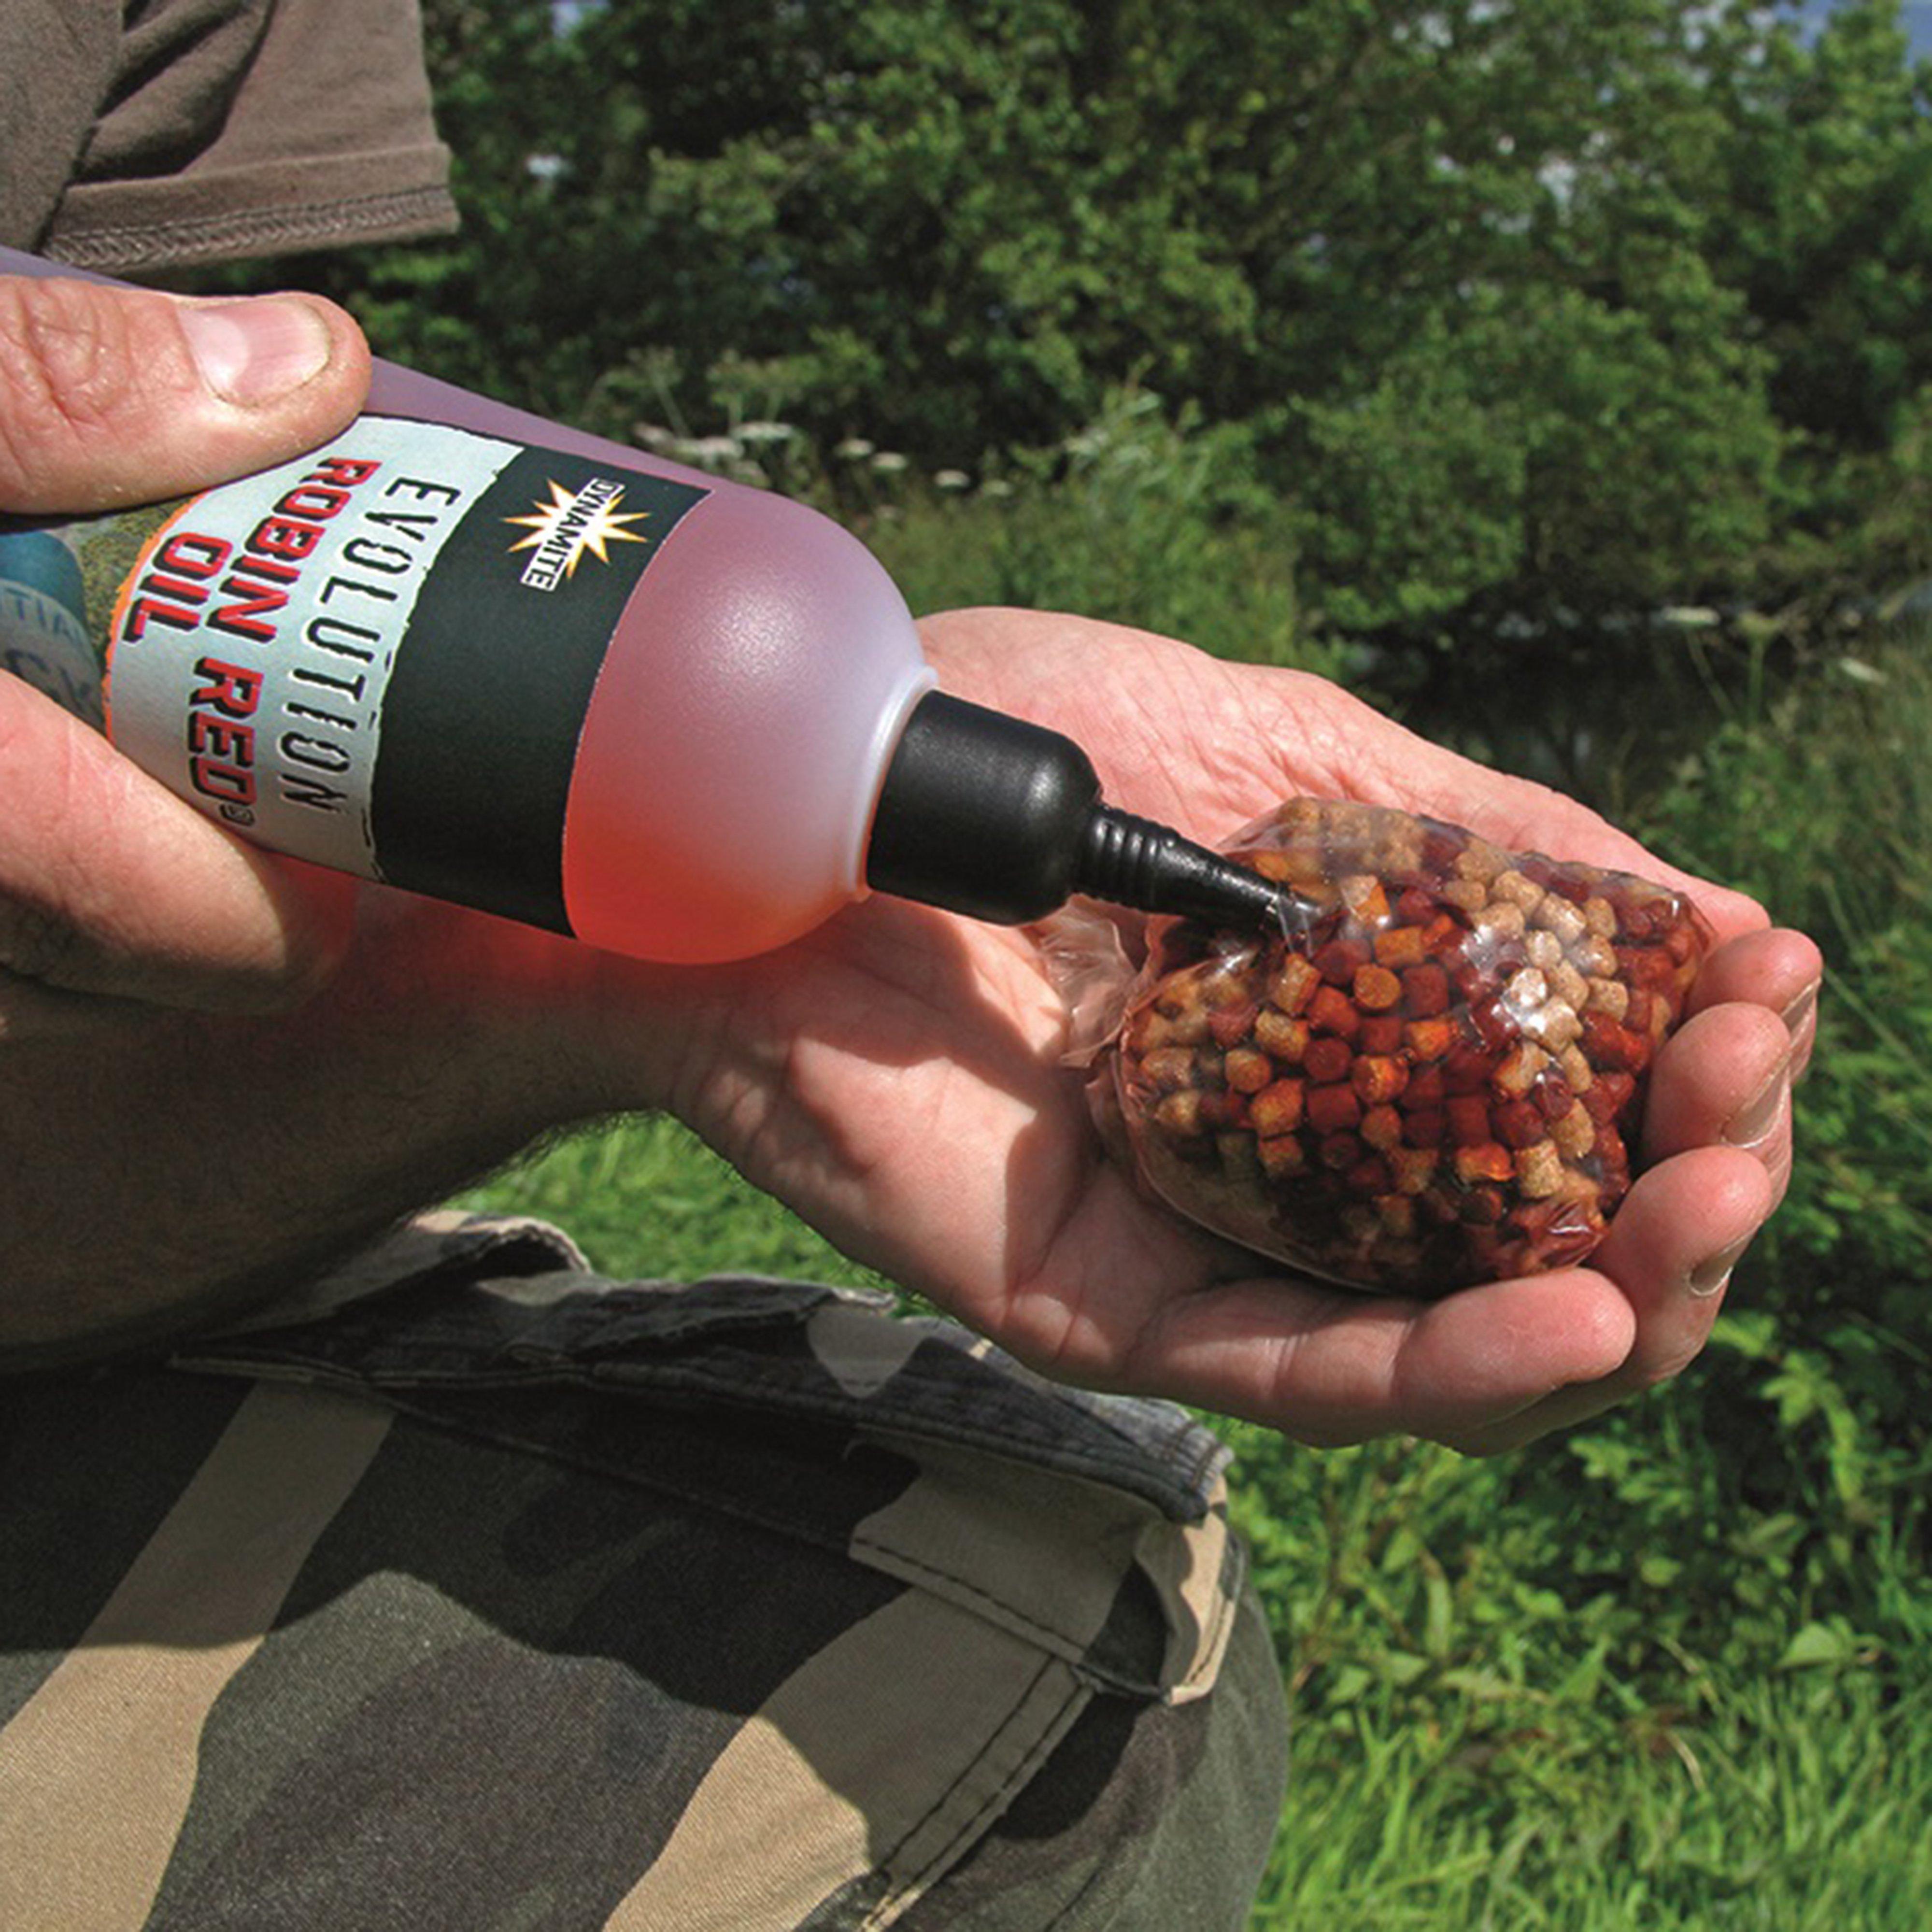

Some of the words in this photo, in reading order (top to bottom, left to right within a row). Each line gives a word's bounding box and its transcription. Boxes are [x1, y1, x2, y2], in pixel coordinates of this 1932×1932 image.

[122, 531, 233, 643] OIL
[205, 457, 383, 644] ROBIN
[525, 478, 622, 588] DYNAMITE
[279, 477, 461, 813] EVOLUTION
